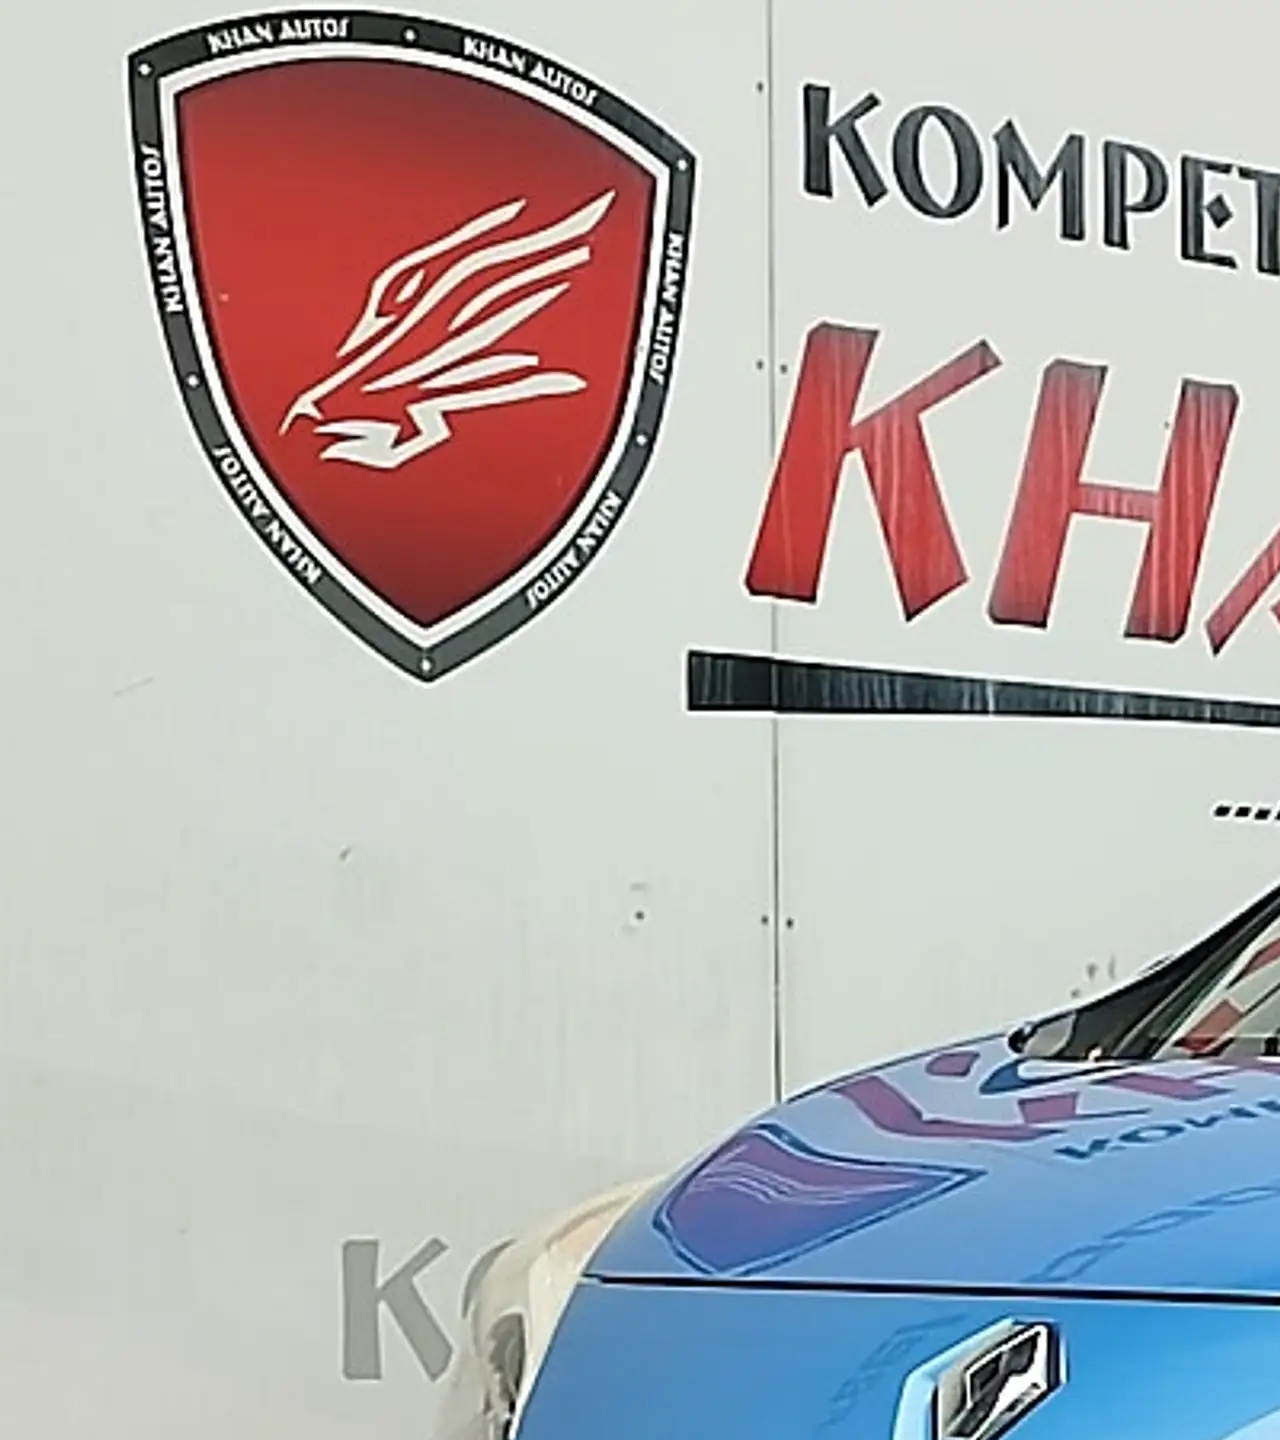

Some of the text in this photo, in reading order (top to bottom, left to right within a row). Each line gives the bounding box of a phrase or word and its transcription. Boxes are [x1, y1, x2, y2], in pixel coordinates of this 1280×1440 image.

[207, 17, 350, 54] KHAN AUTOS
[463, 37, 597, 106] KHAN AUTOS
